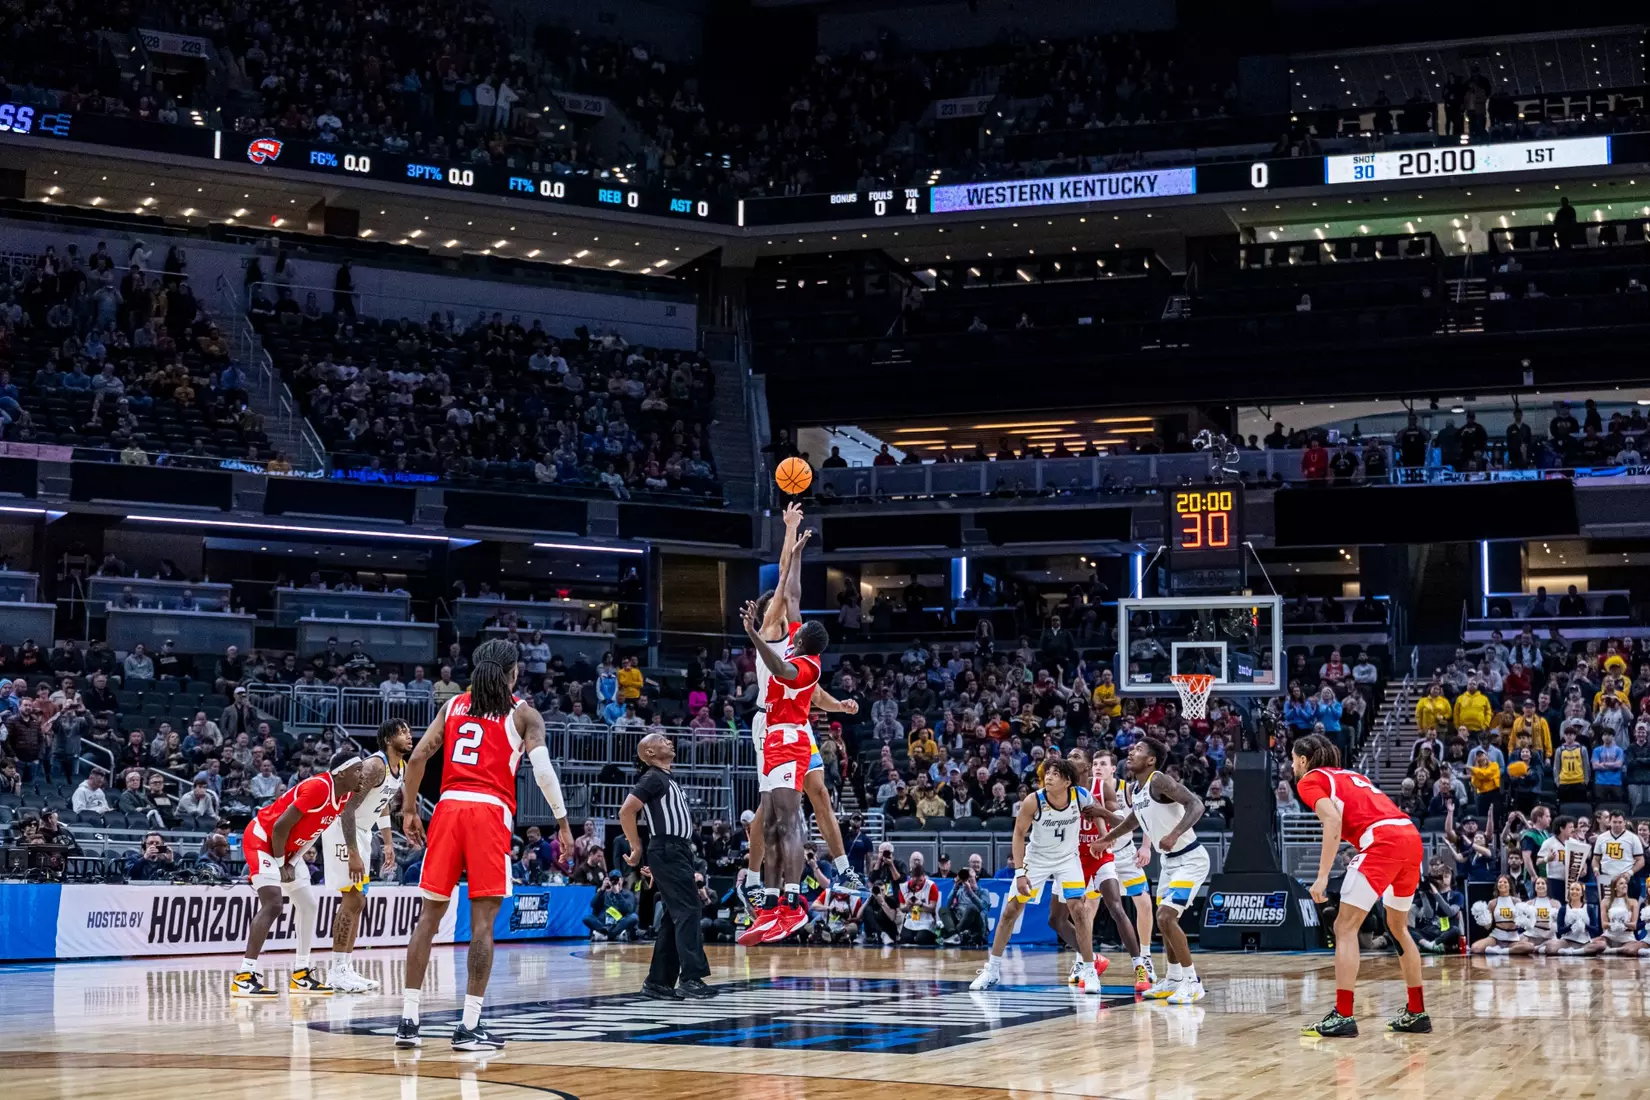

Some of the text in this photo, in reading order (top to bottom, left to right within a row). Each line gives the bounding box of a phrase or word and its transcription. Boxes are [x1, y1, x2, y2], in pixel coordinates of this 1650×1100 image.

[310, 151, 370, 173] FG% 0.0
[1353, 155, 1375, 164] SHOT
[1400, 149, 1475, 175] 20:00
[1526, 147, 1555, 163] 1ST
[407, 164, 474, 186] 3PT% 0.0
[1251, 162, 1268, 188] 0
[1354, 165, 1375, 180] 30
[509, 177, 565, 198] FT% 0.0
[830, 188, 919, 204] BONUS FOULS TOL
[967, 174, 1159, 206] WESTERN KENTUCKY
[599, 189, 639, 208] REB 0
[670, 198, 708, 217] AST 0
[875, 198, 917, 216] 0 4
[1176, 491, 1232, 513] 20:00
[1181, 512, 1228, 547] 30
[451, 721, 484, 766] 2
[1054, 828, 1066, 842] 4
[1606, 842, 1624, 860] MU
[518, 896, 540, 910] MARCH
[1223, 895, 1265, 908] MARCH
[87, 911, 144, 928] HOSTED BY
[148, 896, 259, 943] HORIZON
[520, 910, 548, 924] MADNESS
[1228, 908, 1284, 921] MADNESS
